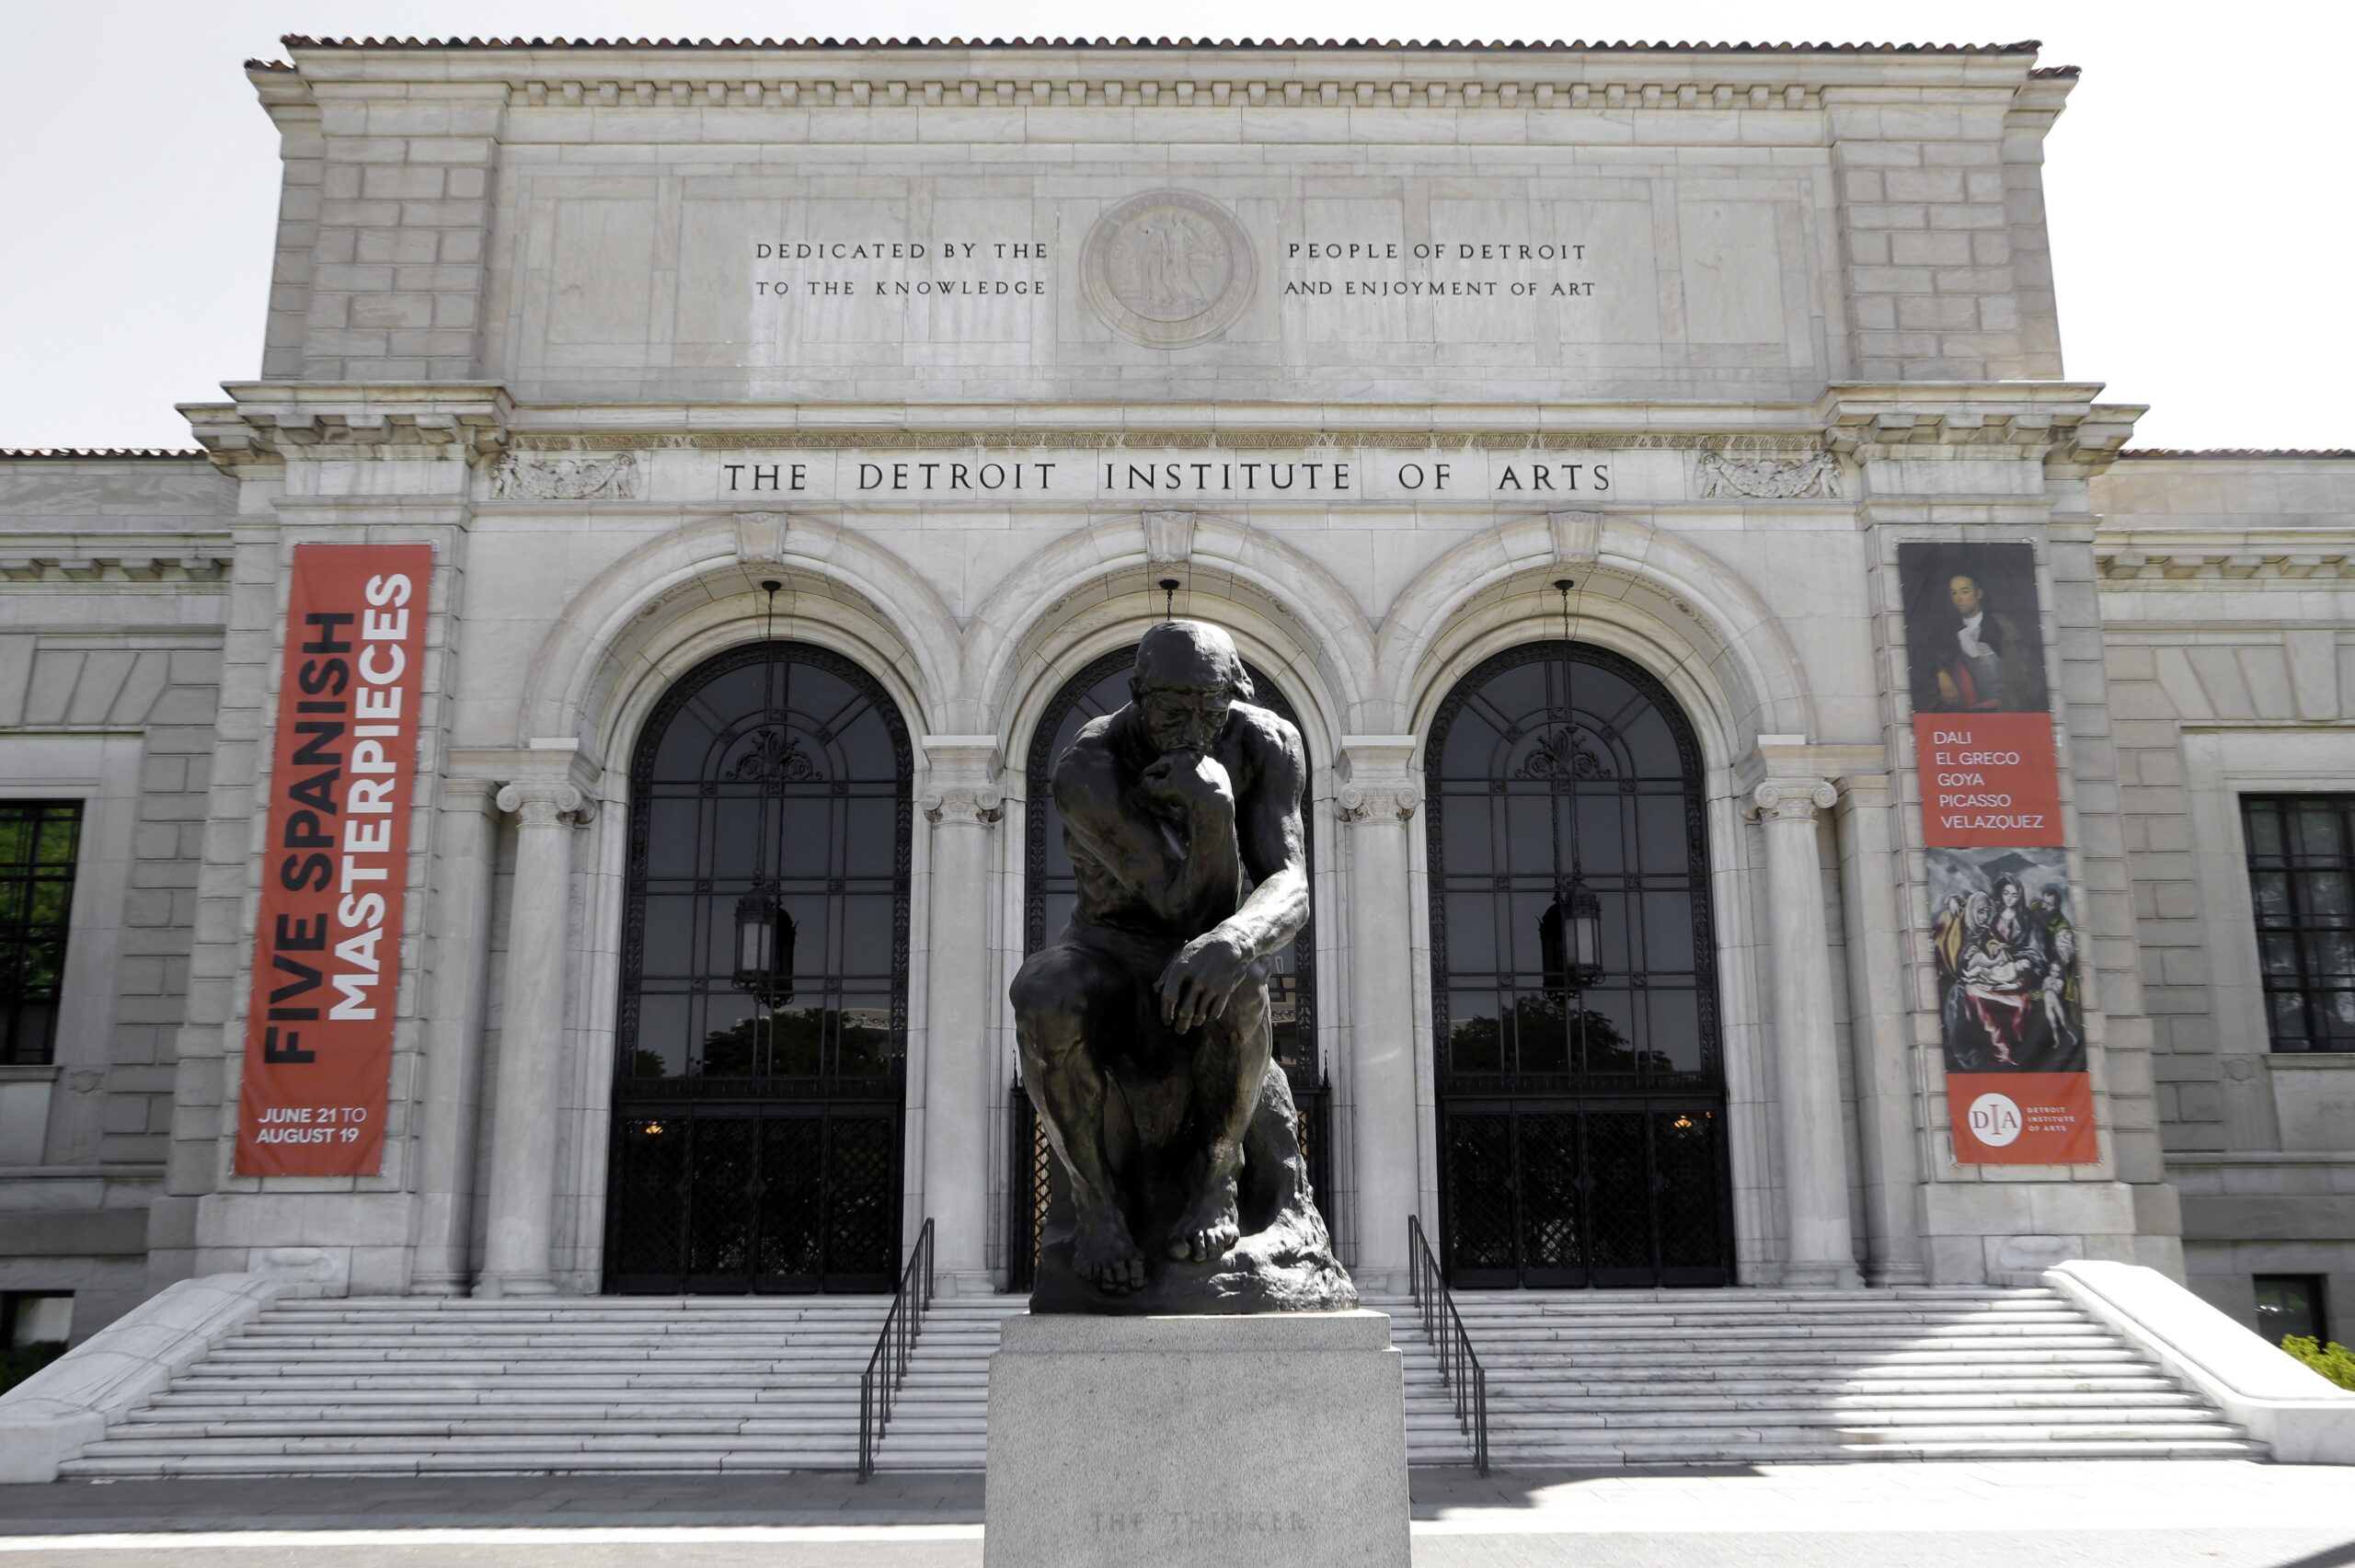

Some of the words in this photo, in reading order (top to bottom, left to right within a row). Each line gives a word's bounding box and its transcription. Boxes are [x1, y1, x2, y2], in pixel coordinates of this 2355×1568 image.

[756, 243, 925, 259] DEDICATED
[944, 243, 977, 258] BY
[994, 243, 1048, 259] THE
[1289, 243, 1398, 259] PEOPLE
[1413, 243, 1446, 259] OF
[1459, 244, 1586, 260] DETROIT
[756, 281, 789, 296] TO
[807, 281, 855, 295] THE
[876, 280, 1045, 296] KNOWLEDGE
[1283, 280, 1333, 296] AND
[1345, 280, 1498, 297] ENJOYMENT
[1511, 281, 1538, 296] OF
[1550, 281, 1595, 296] ART
[723, 464, 806, 491] THE
[856, 463, 1056, 490] DETROIT
[1105, 463, 1350, 490] INSTITUTE
[1397, 463, 1451, 490] OF
[1496, 464, 1610, 491] ARTS
[1933, 731, 1972, 745] DALI
[280, 612, 355, 893] SPANISH
[1935, 751, 1957, 765] EL
[1959, 751, 2021, 765] GRECO
[1936, 773, 1985, 786] GOYA
[328, 573, 413, 1021] MASTERPIECES
[1938, 794, 2012, 807] PICASSO
[1940, 815, 2045, 830] VELAZQUEZ
[263, 912, 328, 1065] FIVE
[257, 1107, 314, 1123] JUNE
[316, 1107, 338, 1123] 21
[339, 1106, 368, 1123] TO
[1971, 1104, 2019, 1136] DIA
[256, 1127, 338, 1143] AUGUST
[339, 1127, 360, 1143] 19
